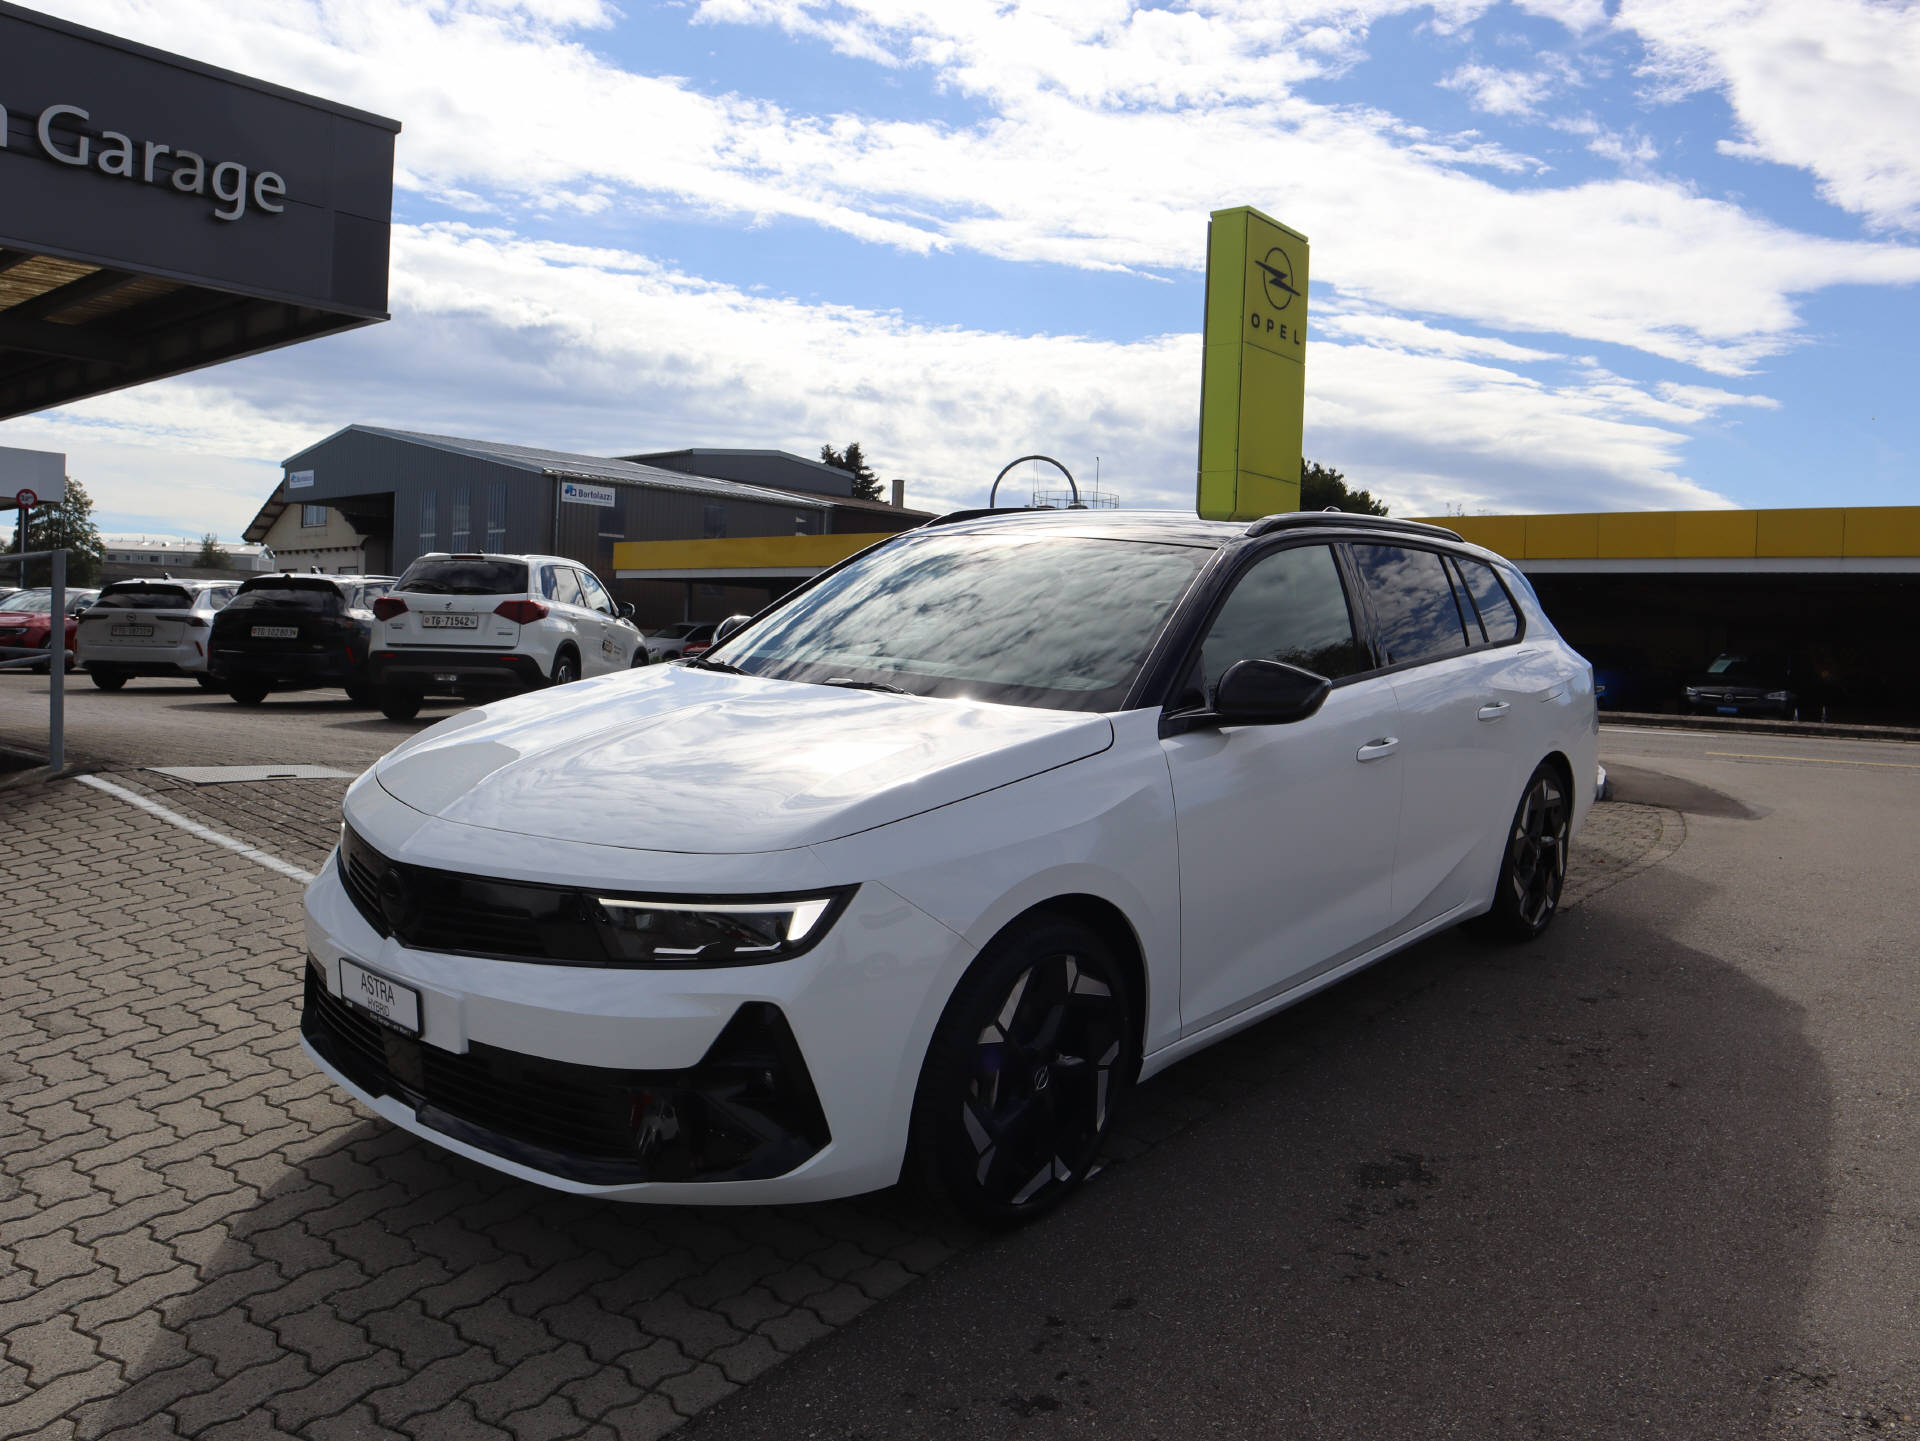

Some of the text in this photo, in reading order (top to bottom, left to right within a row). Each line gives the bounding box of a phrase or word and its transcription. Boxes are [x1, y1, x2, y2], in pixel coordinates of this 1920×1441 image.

[37, 104, 287, 221] Garage
[1251, 313, 1300, 345] OPEL
[578, 488, 613, 501] Bortolazzi
[361, 972, 396, 1007] ASTRA
[367, 996, 390, 1017] HYBRID
